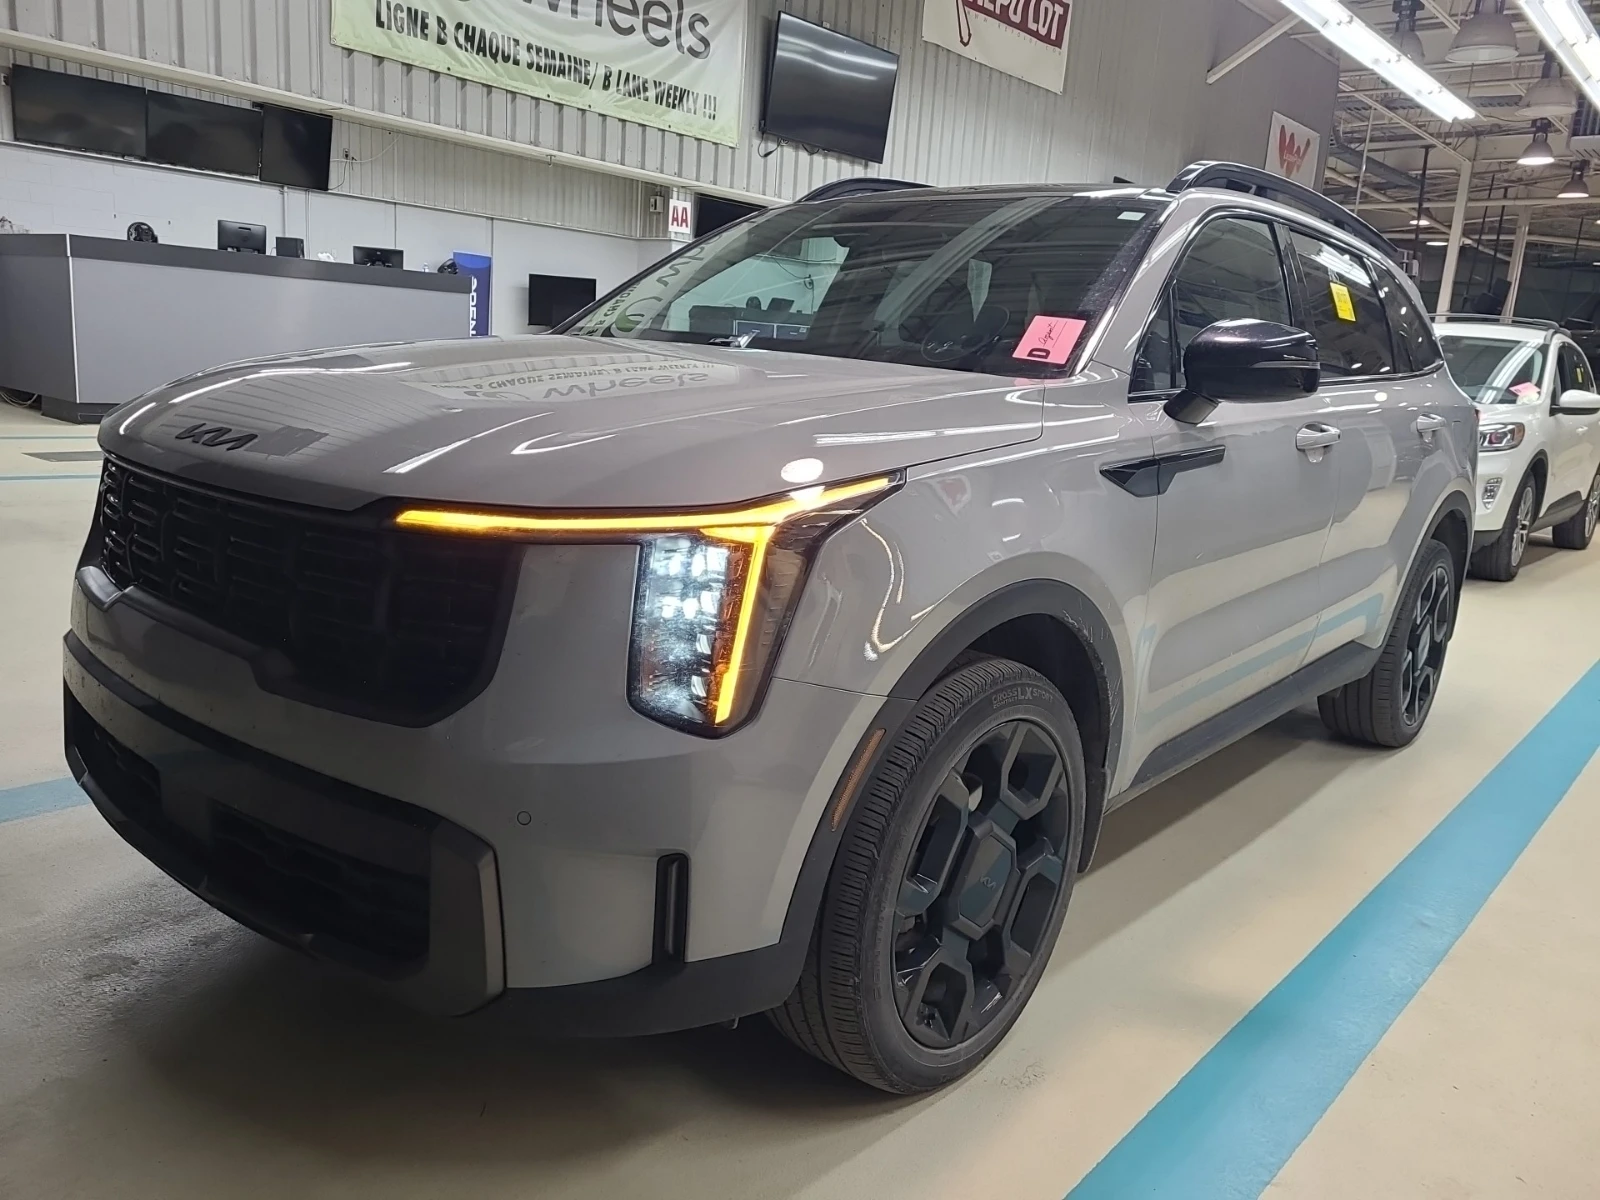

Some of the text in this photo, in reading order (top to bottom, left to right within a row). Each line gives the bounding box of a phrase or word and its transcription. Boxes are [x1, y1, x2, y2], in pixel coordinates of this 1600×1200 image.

[521, 0, 711, 59] eels
[375, 0, 717, 121] LIGNE B CHAQUE SEMAINE/ B LANE WEEKLY !!!
[671, 205, 689, 229] AA
[1027, 347, 1051, 360] D
[175, 422, 258, 451] KIA
[991, 688, 1018, 704] CROSS
[1018, 686, 1033, 700] LX
